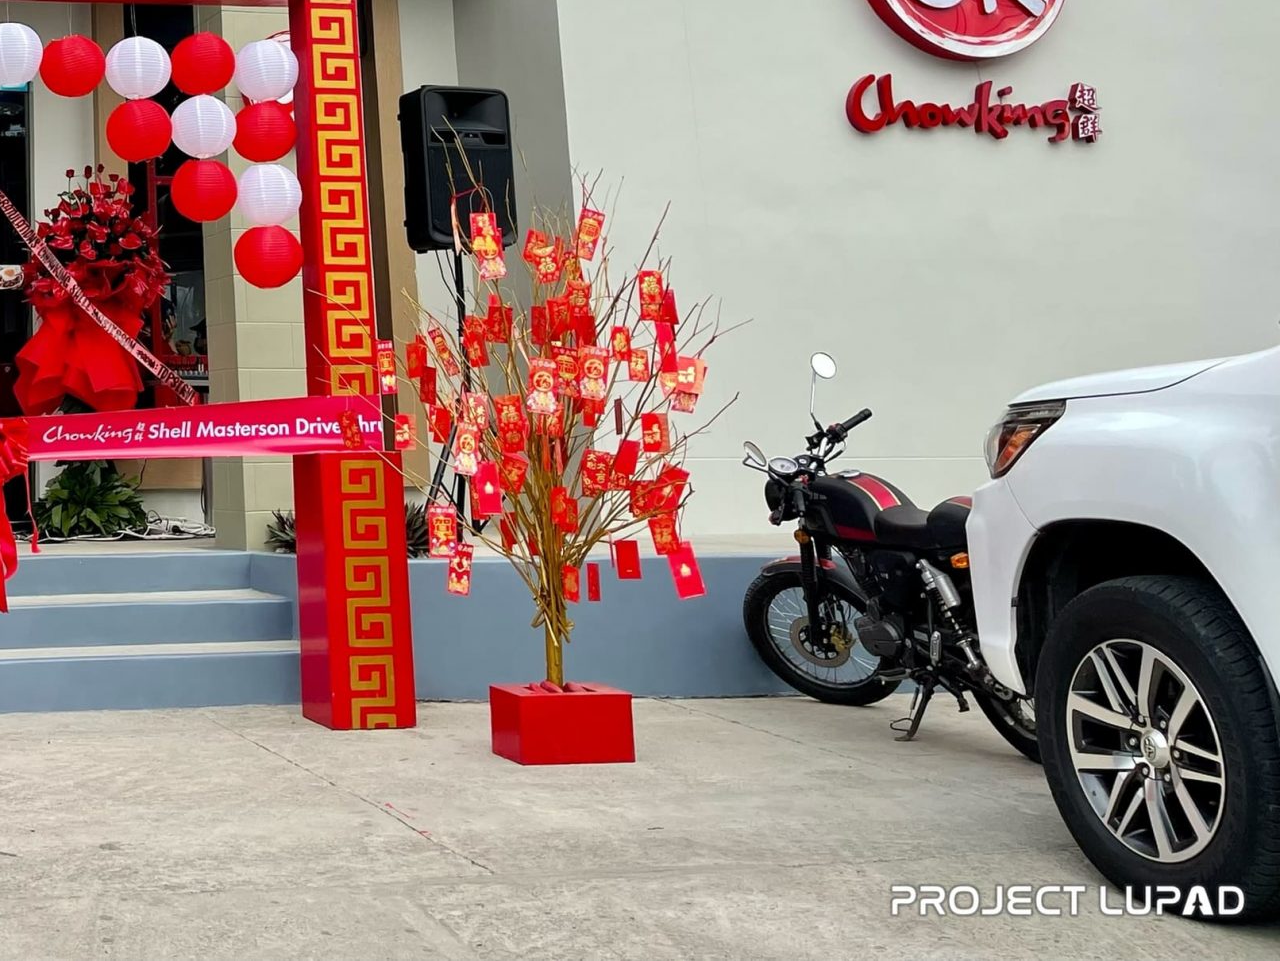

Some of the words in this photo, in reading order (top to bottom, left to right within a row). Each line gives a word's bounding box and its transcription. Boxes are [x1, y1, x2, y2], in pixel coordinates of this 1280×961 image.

[846, 74, 1070, 143] Chowking
[42, 425, 133, 444] Chowking
[148, 420, 190, 440] Shell
[196, 419, 290, 438] Masterson
